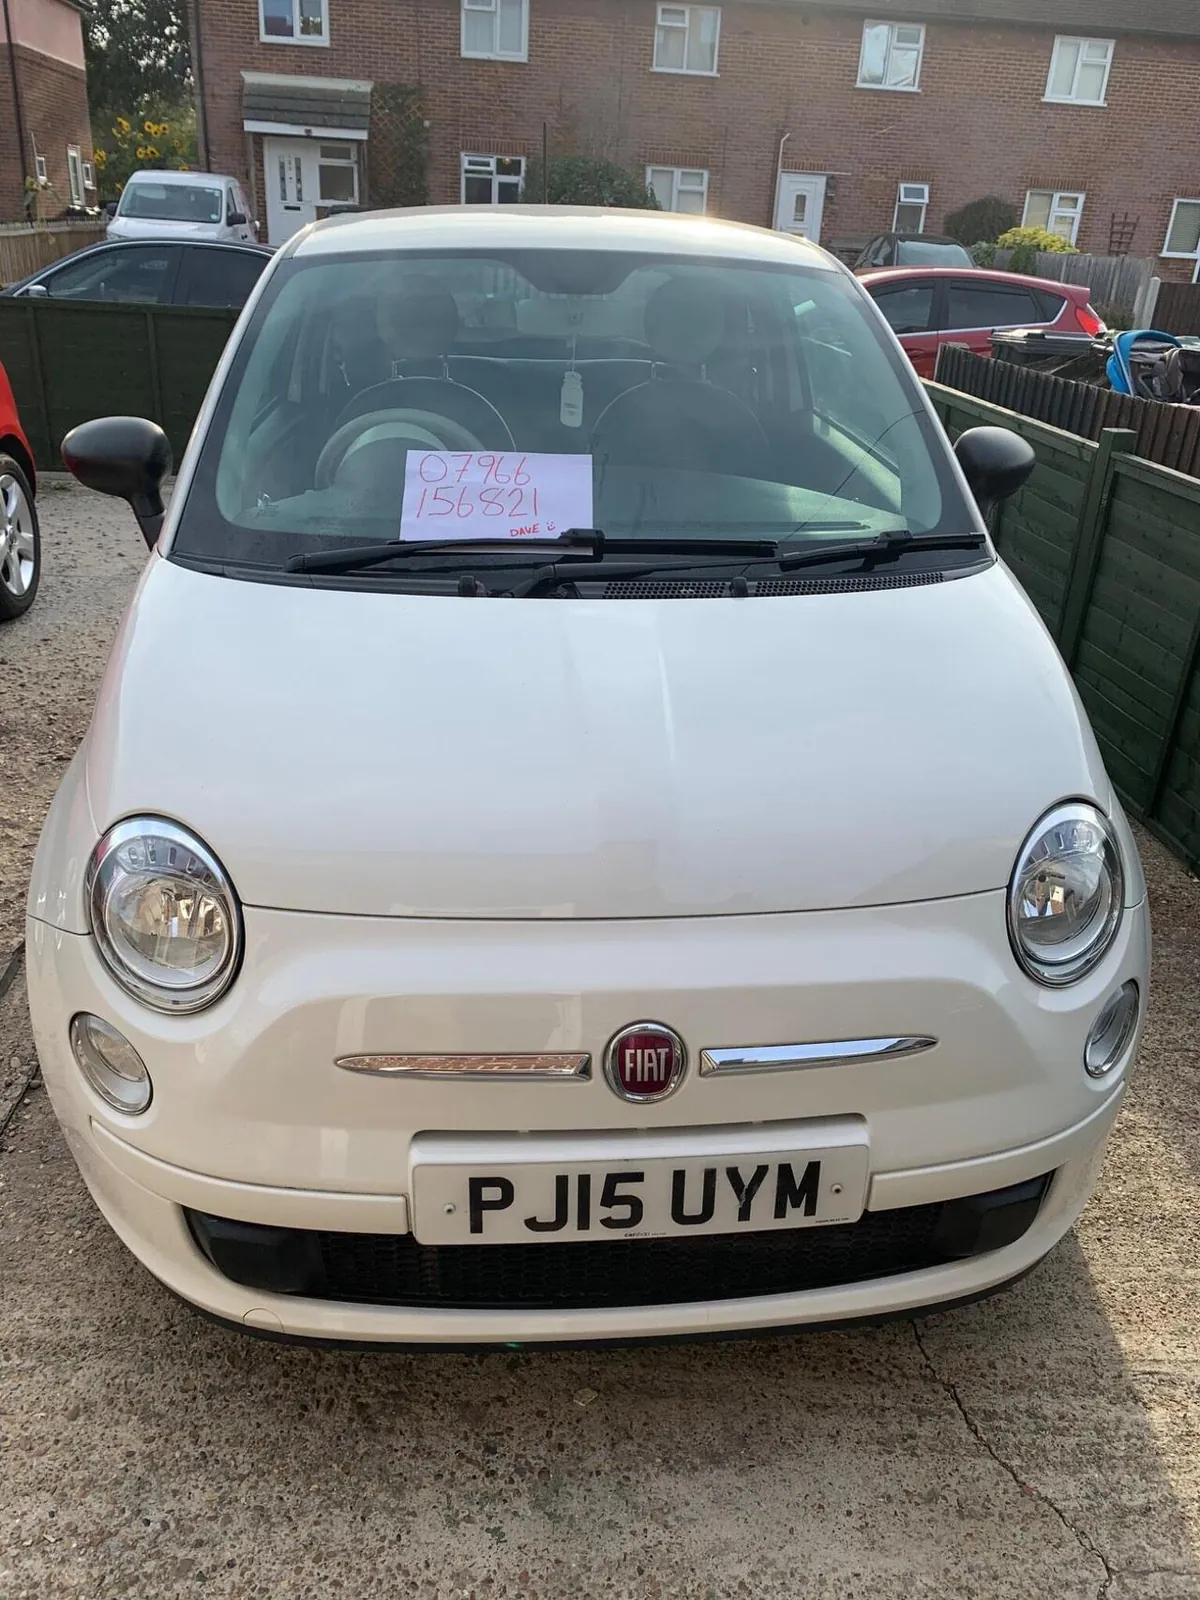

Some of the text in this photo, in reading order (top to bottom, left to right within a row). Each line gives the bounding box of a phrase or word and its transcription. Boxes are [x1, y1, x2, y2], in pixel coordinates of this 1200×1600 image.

[419, 454, 531, 486] 07966
[416, 485, 539, 518] 156821
[509, 523, 540, 537] DAVE
[624, 1048, 669, 1082] FIAT
[468, 1160, 821, 1234] PJ15 UYM
